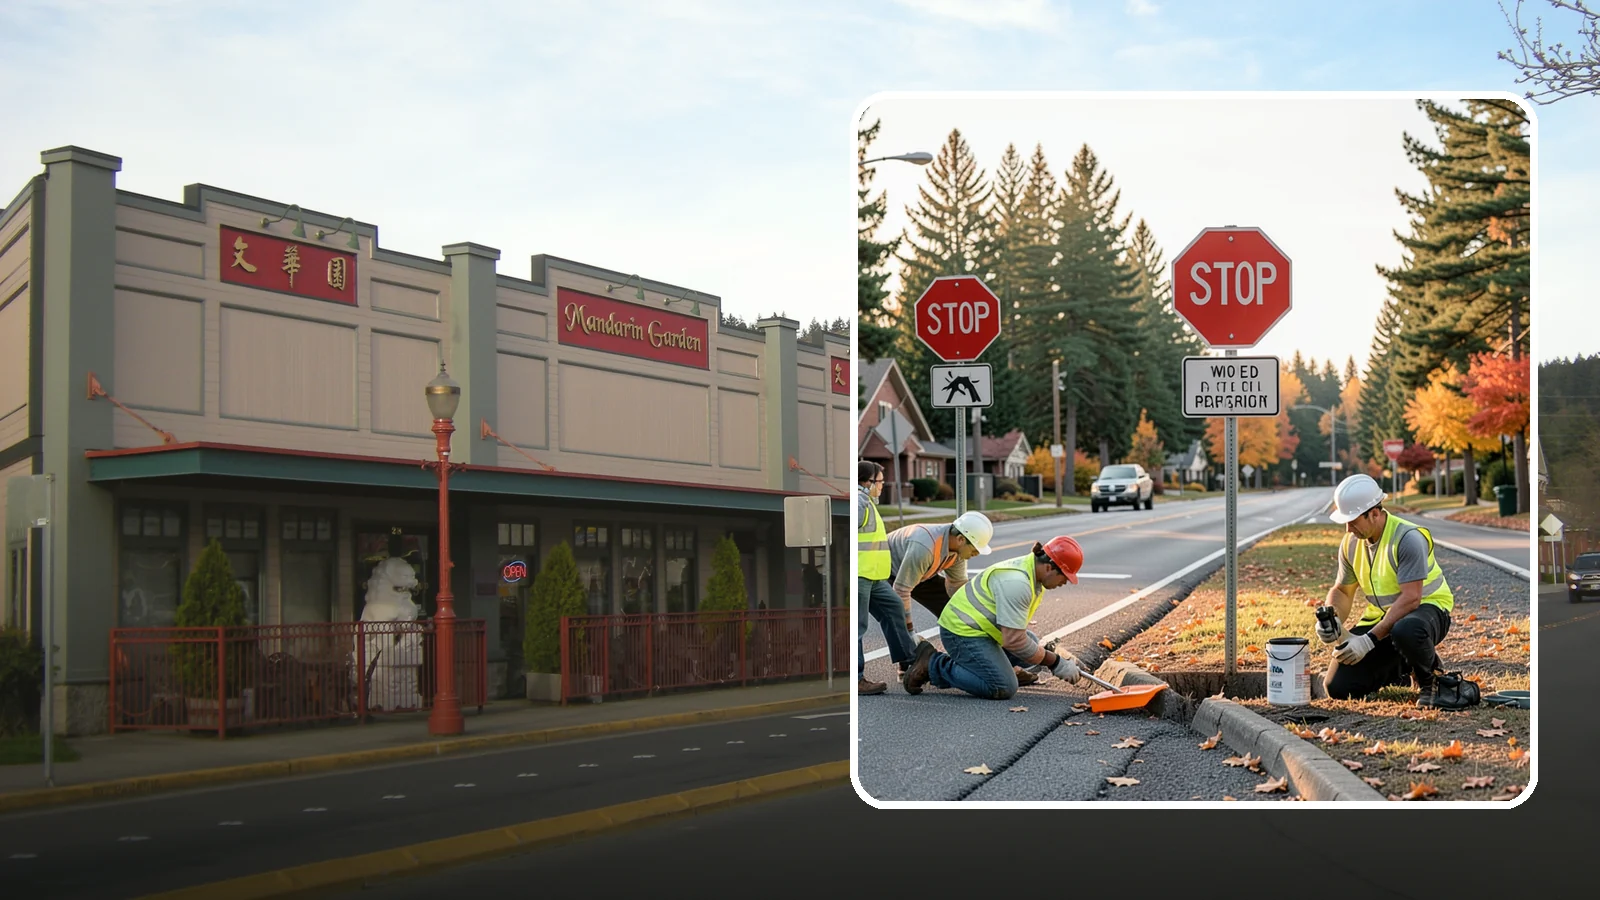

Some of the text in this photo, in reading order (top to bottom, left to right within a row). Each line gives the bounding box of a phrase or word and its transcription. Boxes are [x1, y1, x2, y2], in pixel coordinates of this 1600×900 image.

[230, 235, 346, 291] 文華園
[1189, 261, 1277, 306] STOP
[564, 302, 702, 352] Mandarin Garden
[927, 301, 990, 335] STOP
[503, 565, 527, 578] OPEN
